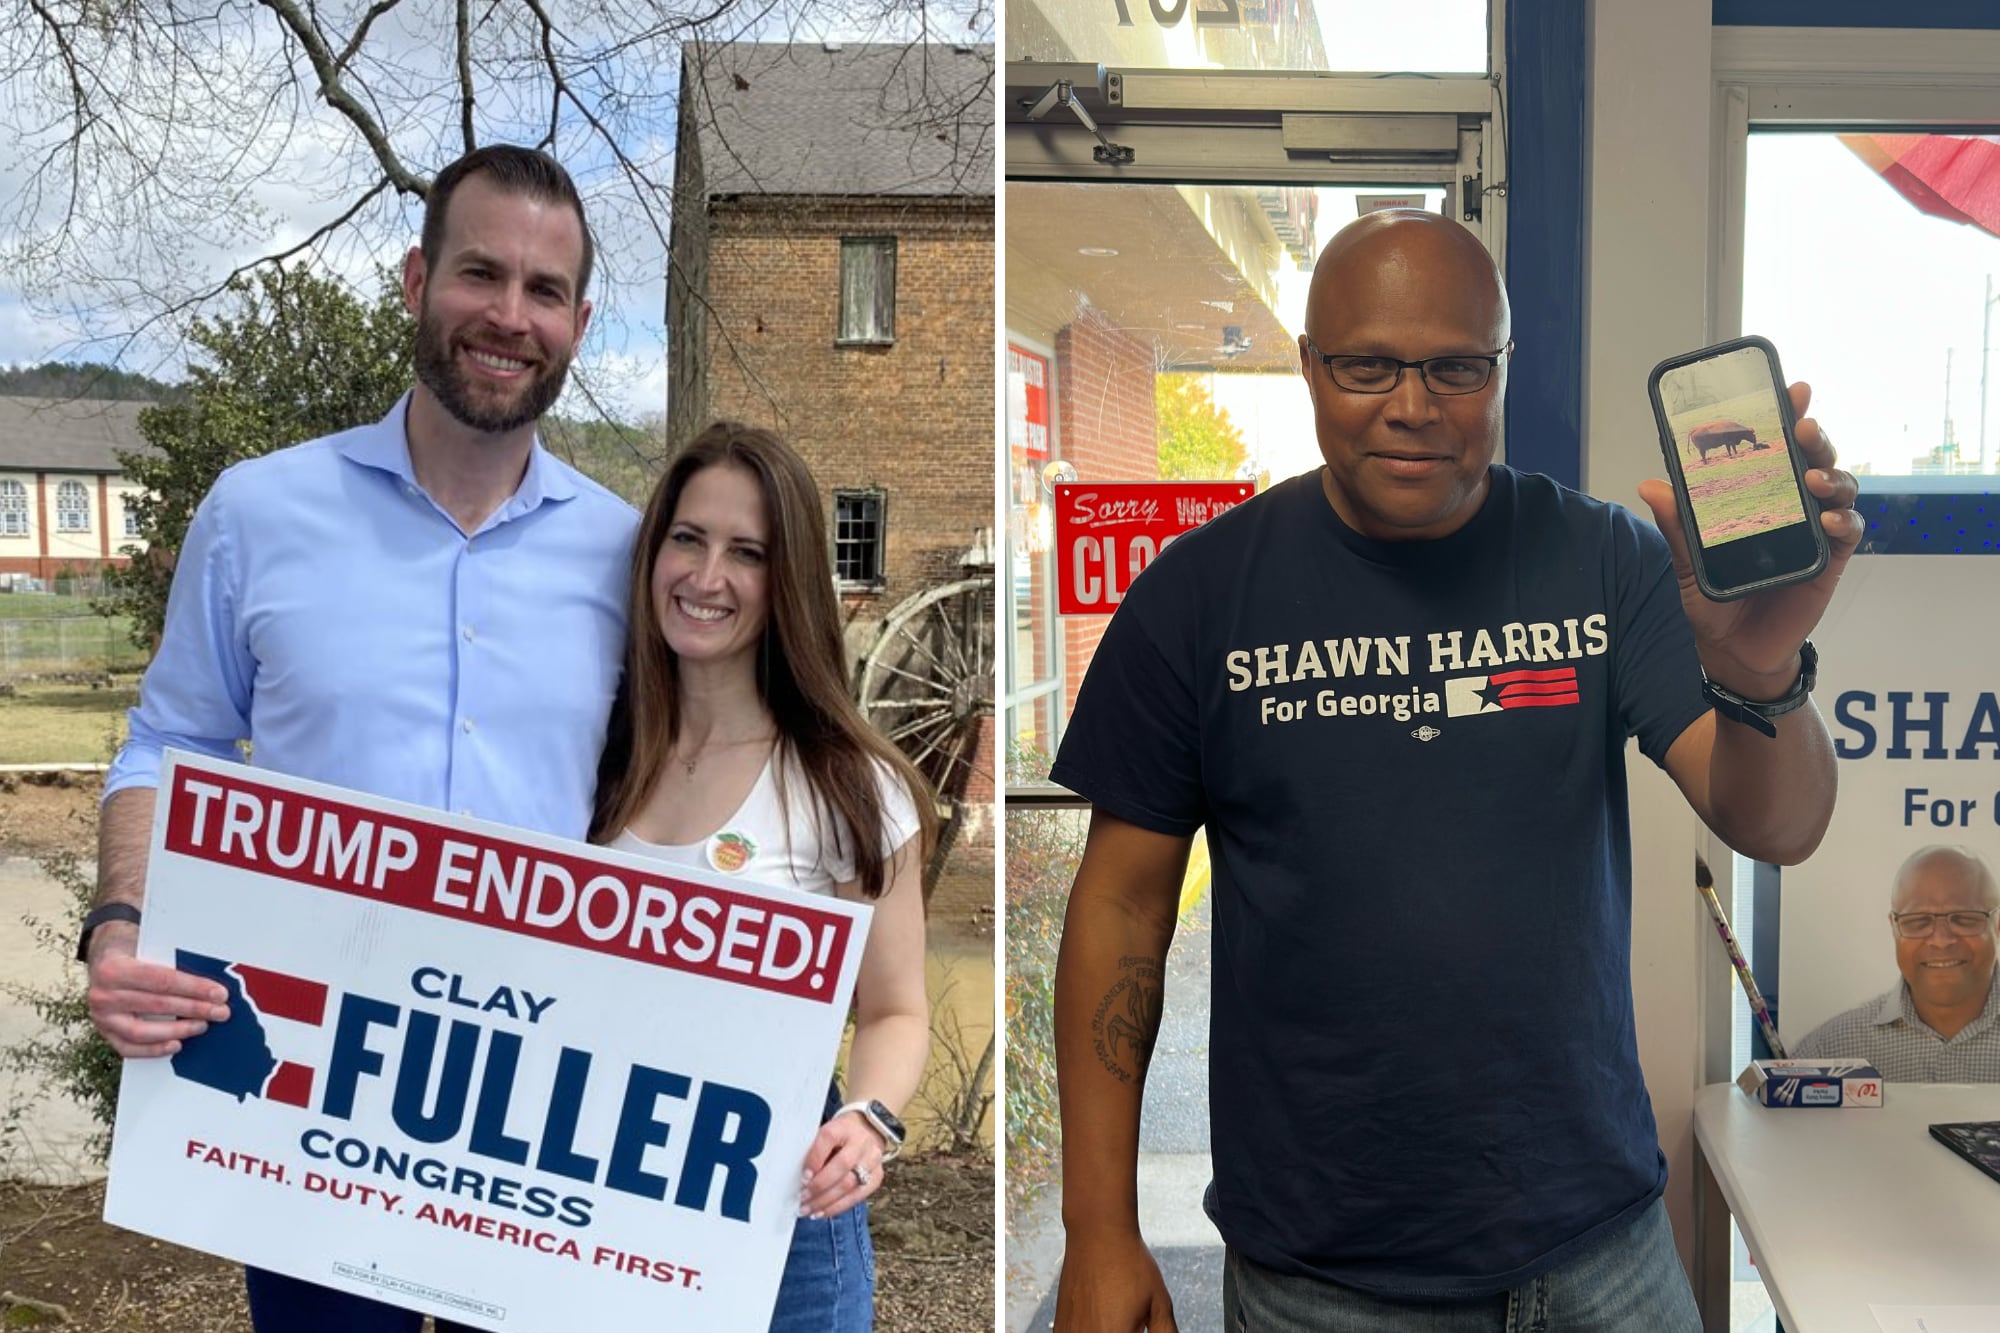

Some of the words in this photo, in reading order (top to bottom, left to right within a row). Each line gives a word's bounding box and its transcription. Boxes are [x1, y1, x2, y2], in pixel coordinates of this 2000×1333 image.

[1070, 493, 1163, 527] Sorry
[1227, 636, 1411, 692] SHAWN
[1428, 613, 1608, 673] HARRIS
[1262, 696, 1308, 725] For
[1317, 686, 1440, 722] Georgia
[1904, 788, 1977, 827] For
[184, 779, 418, 889] TRUMP
[433, 839, 837, 990] ENDORSED!
[411, 966, 557, 1024] CLAY
[322, 991, 772, 1223] FULLER
[186, 1139, 291, 1186] FAITH.
[303, 1173, 404, 1215] DUTY.
[415, 1202, 581, 1261] AMERICA
[593, 1247, 703, 1291] FIRST.
[300, 1128, 594, 1228] CONGRESS
